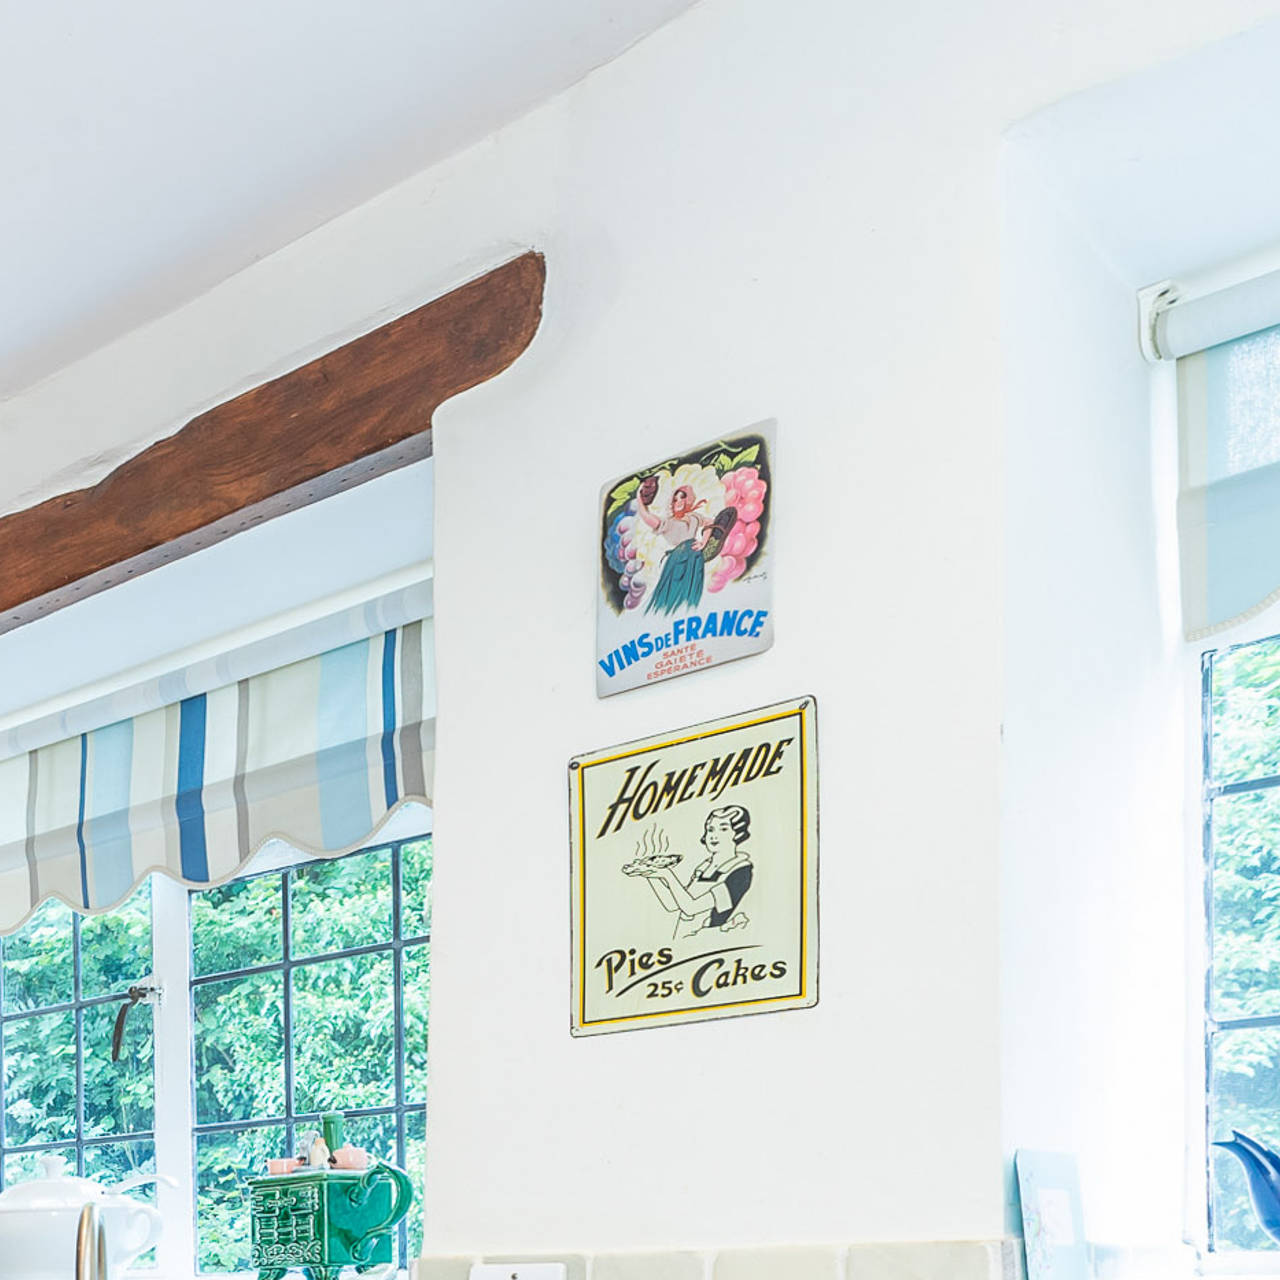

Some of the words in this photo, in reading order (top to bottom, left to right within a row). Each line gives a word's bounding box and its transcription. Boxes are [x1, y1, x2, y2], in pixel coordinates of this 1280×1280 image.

[598, 633, 654, 678] VINS
[654, 632, 672, 651] DE
[672, 609, 769, 645] FRANCE
[596, 737, 795, 839] HOMEMADE
[594, 946, 673, 994] Pies
[691, 957, 788, 998] Cakes
